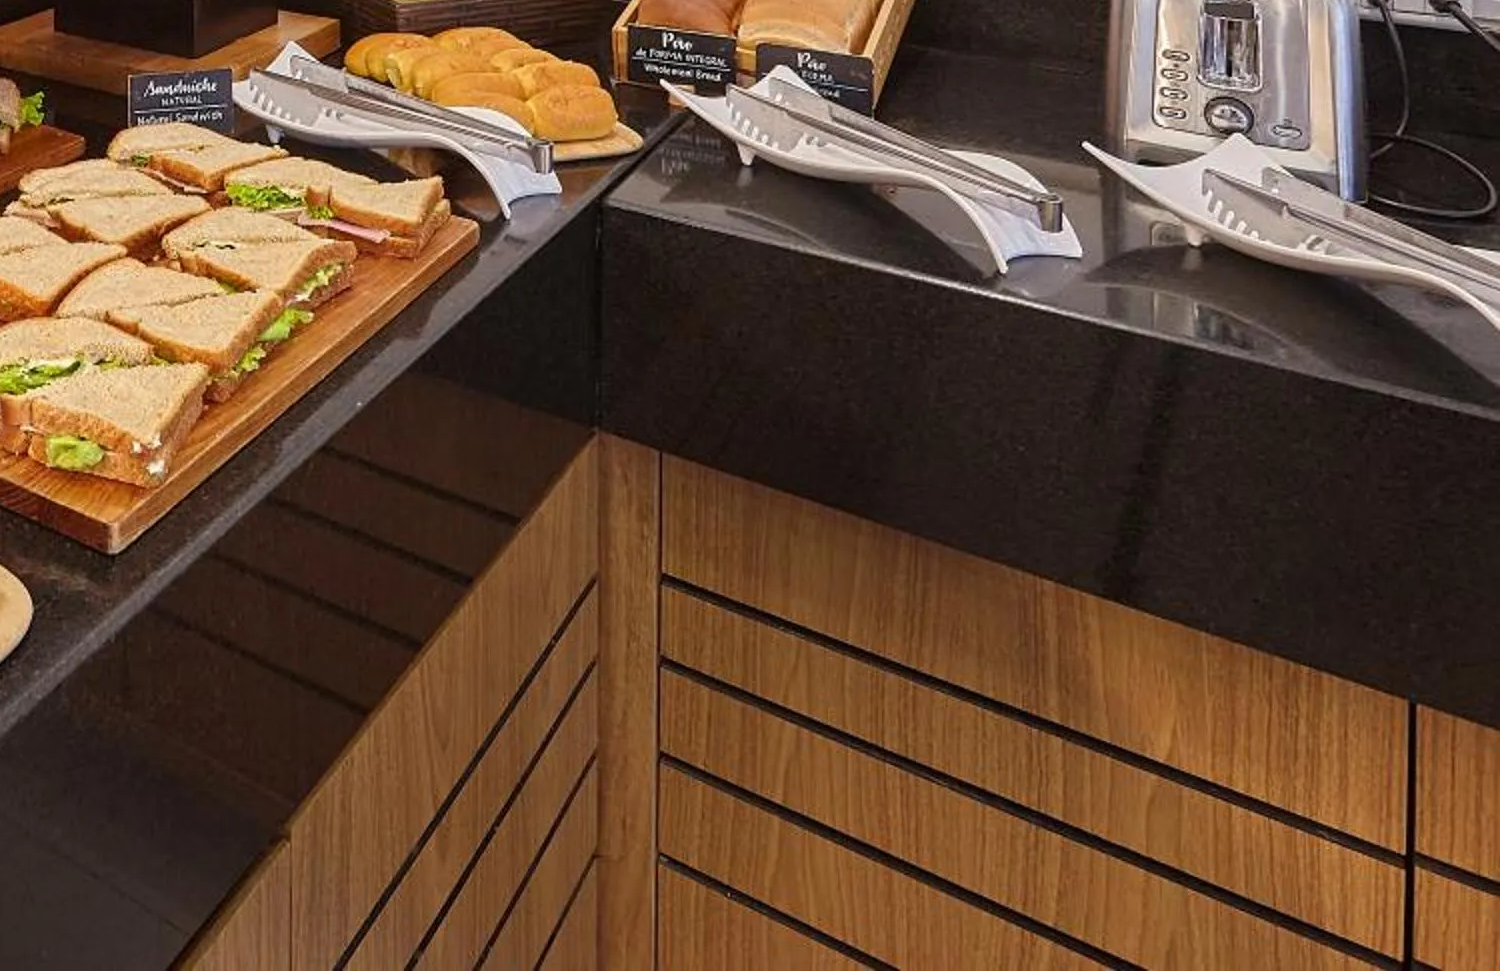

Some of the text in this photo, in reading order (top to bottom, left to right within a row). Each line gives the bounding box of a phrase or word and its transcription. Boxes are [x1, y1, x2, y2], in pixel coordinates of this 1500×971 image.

[649, 48, 683, 62] FORMA
[685, 54, 728, 67] INTEGRAL
[695, 68, 722, 82] Bread
[161, 94, 202, 106] NATURAL
